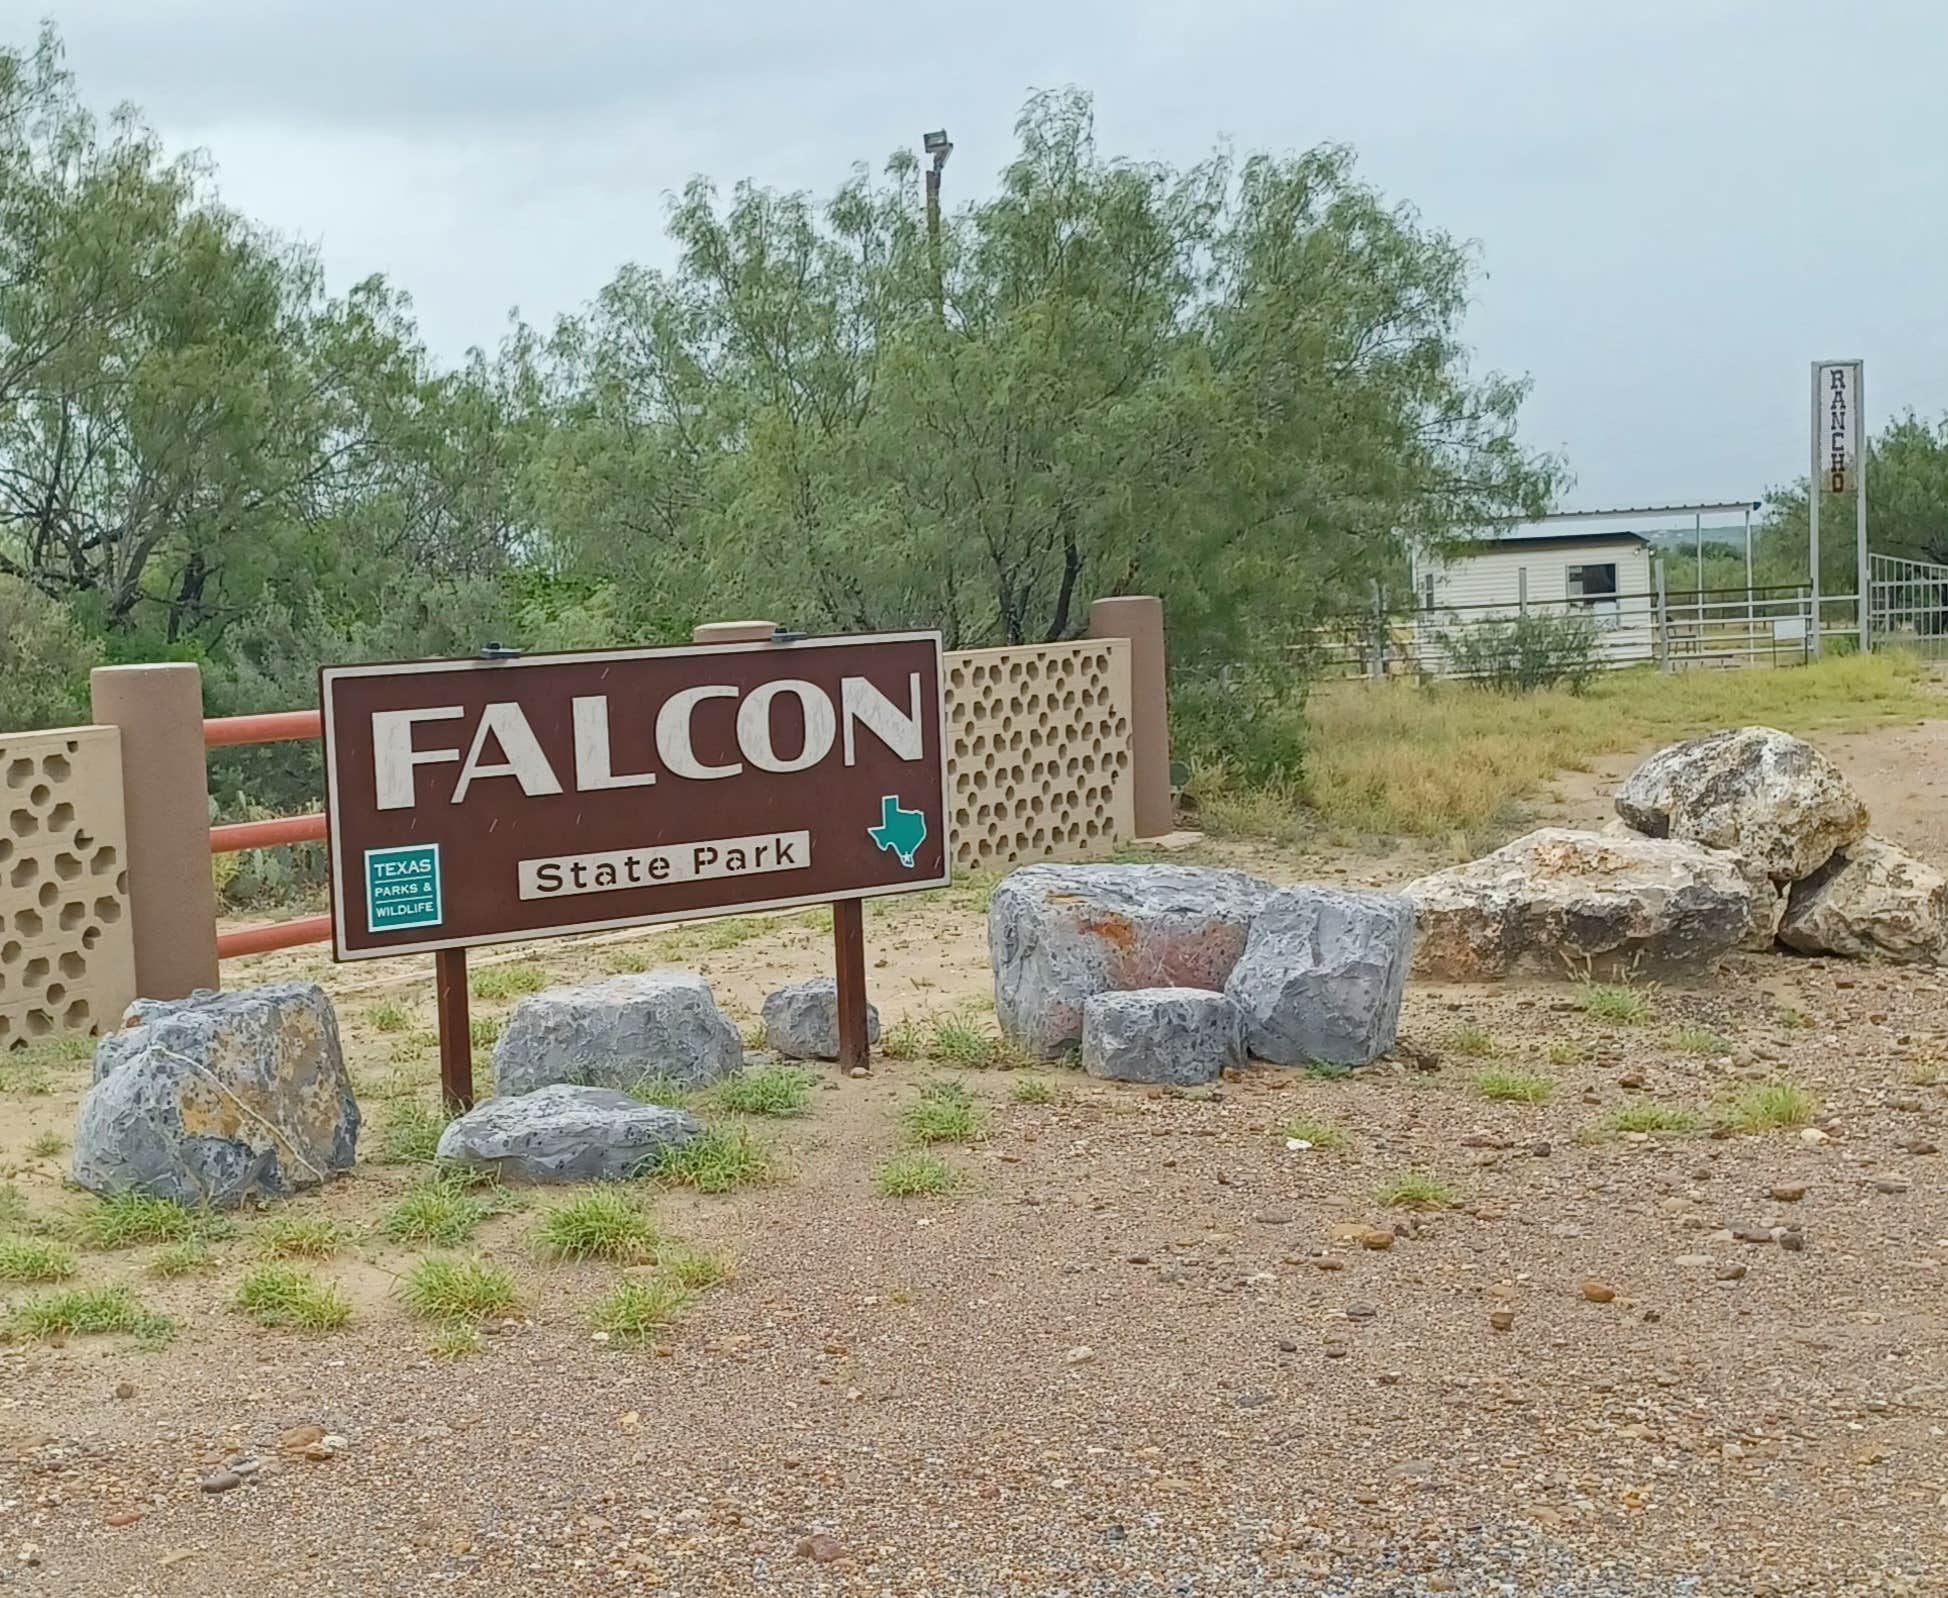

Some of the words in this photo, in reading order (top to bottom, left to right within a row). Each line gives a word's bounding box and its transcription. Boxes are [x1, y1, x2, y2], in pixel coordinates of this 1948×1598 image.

[1830, 369, 1846, 493] RANCHO
[371, 672, 924, 811] FALCON
[374, 859, 432, 877] TEXAS
[536, 855, 671, 893] State
[693, 837, 796, 875] Park
[375, 883, 419, 898] PARKS
[423, 882, 432, 892] &
[376, 901, 435, 918] WILDLIFE
